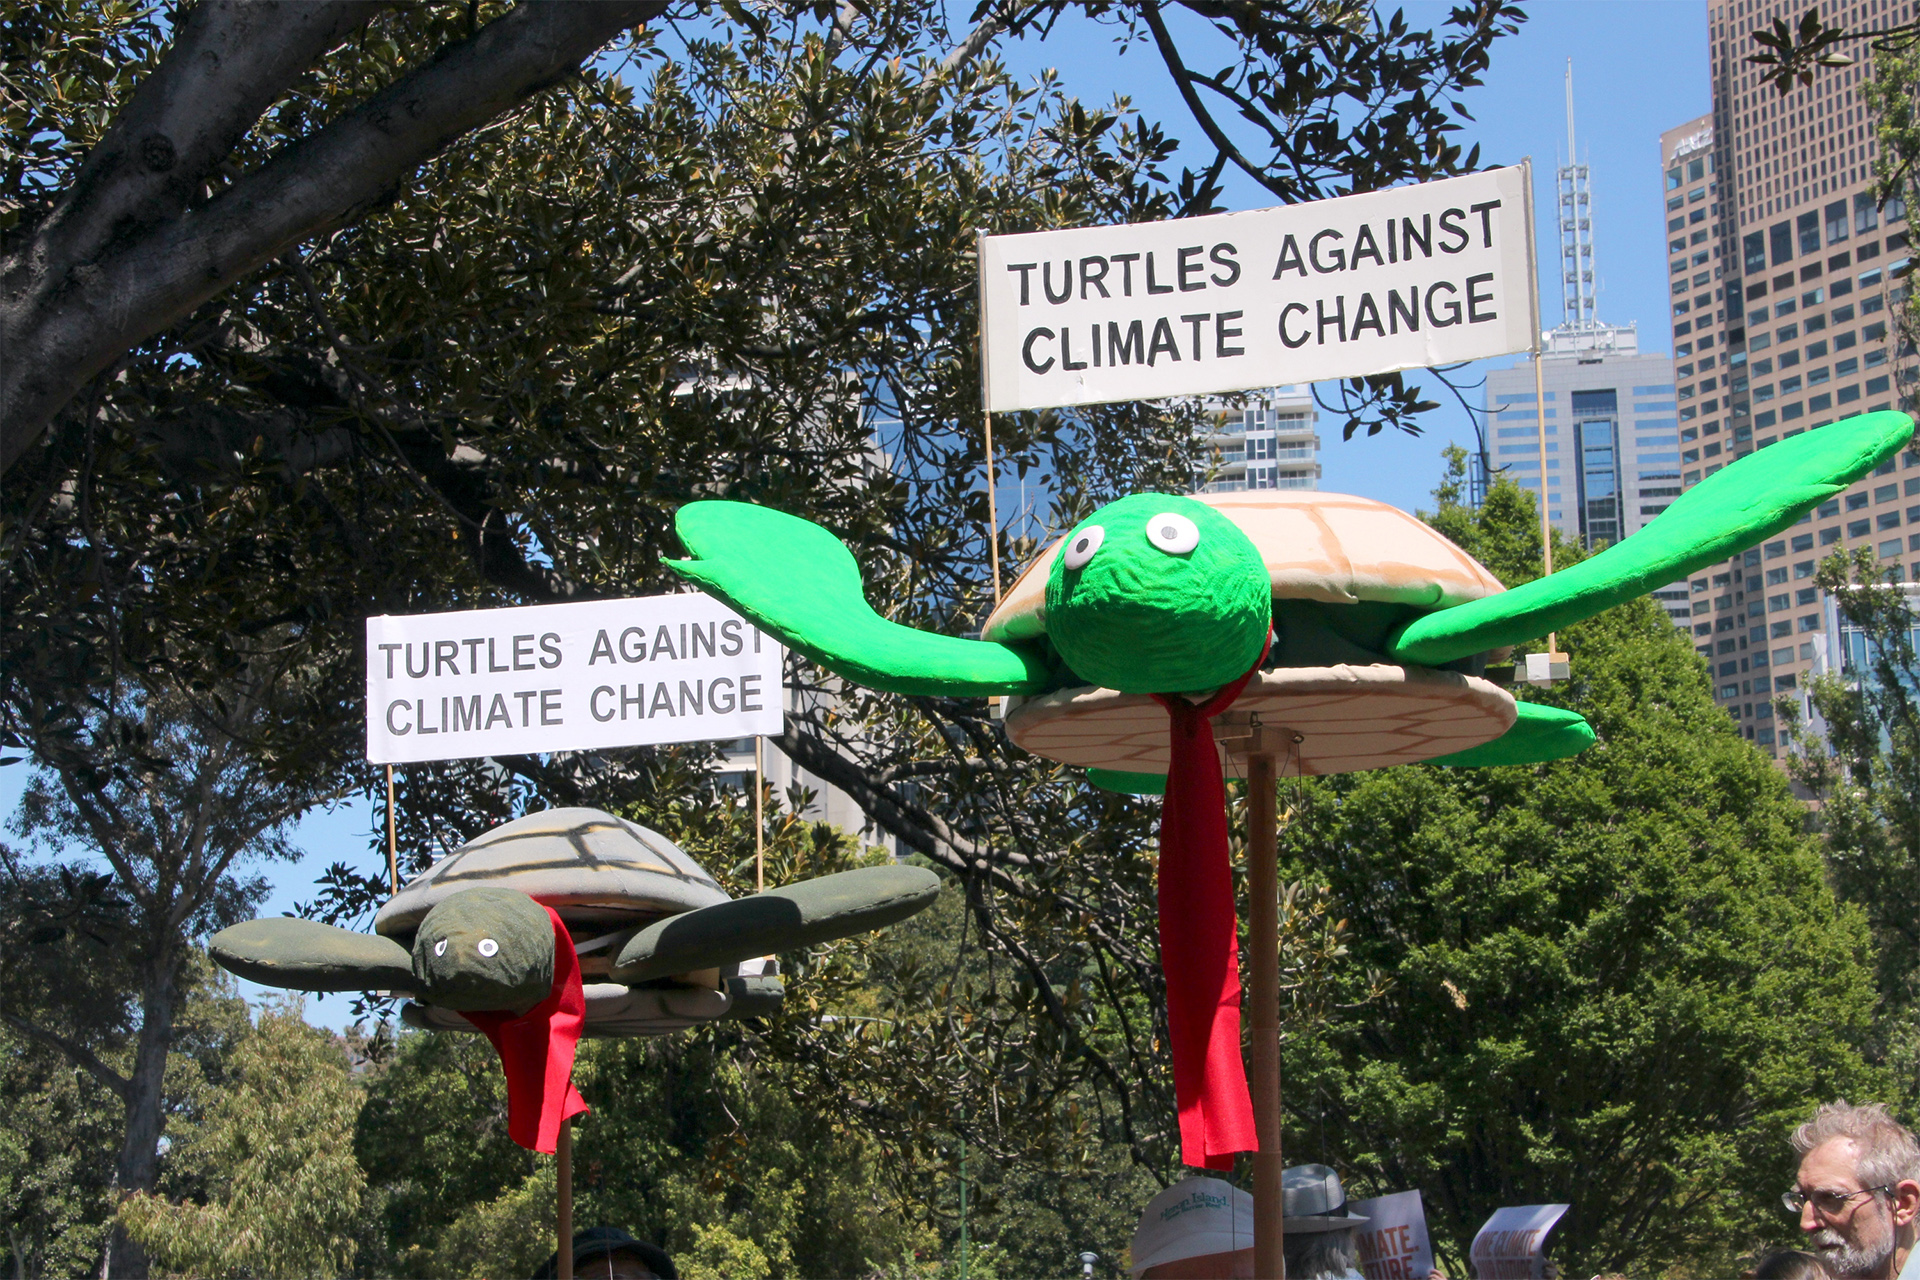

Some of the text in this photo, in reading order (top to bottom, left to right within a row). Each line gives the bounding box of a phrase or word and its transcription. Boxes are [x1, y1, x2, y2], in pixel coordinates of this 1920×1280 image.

[1008, 200, 1501, 305] TURTLES AGAINST
[1023, 273, 1497, 374] CLIMATE CHANGE
[379, 619, 760, 678] TURTLES AGAINST
[387, 675, 762, 735] CLIMATE CHANGE
